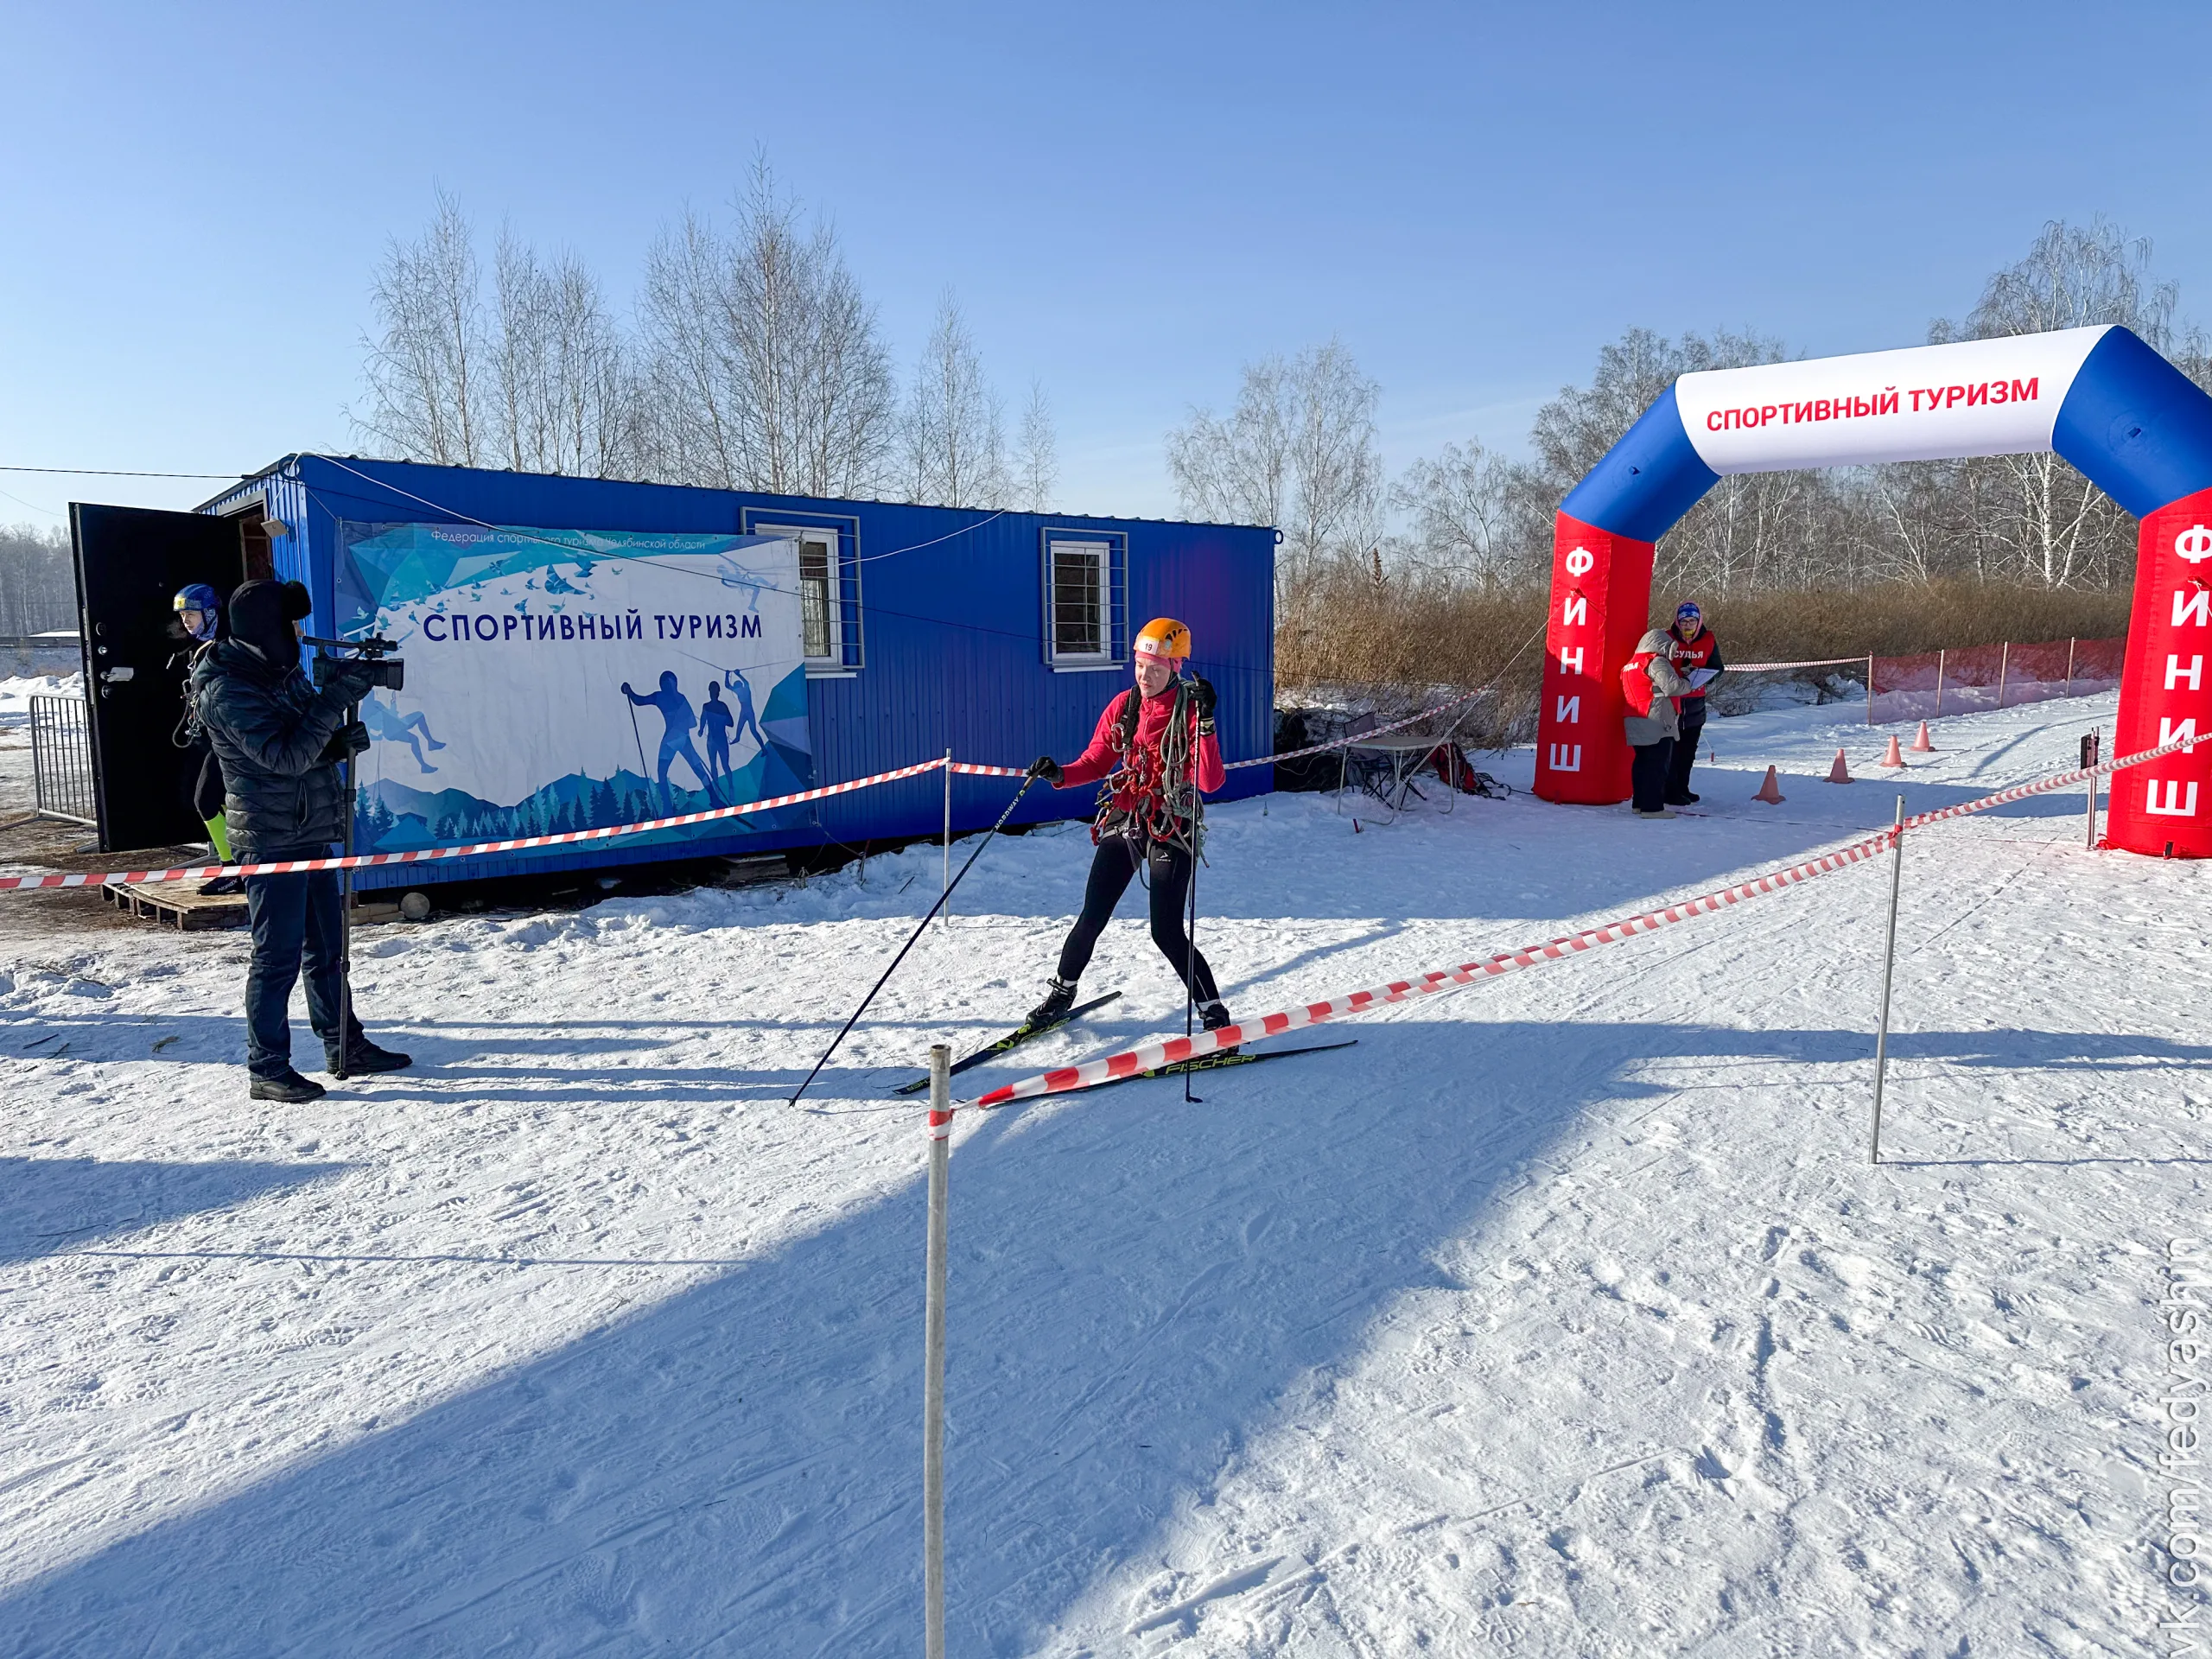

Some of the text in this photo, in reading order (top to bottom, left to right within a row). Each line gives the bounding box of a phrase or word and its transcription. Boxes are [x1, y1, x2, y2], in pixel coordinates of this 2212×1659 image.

[1707, 376, 2039, 431] СПОРТИВНЫЙ ТУРИЗМ
[431, 530, 706, 550] Федерация спортивого туризма Челябинской области
[423, 608, 763, 642] СПОРТИВНЫЙ ТУРИЗМ
[1548, 546, 1595, 772] ФИНИШ
[1674, 650, 1704, 659] СУДЬЯ
[2145, 524, 2212, 817] ФИНИШ
[995, 796, 1019, 830] NORDWAY
[1165, 1054, 1256, 1075] FISCHER
